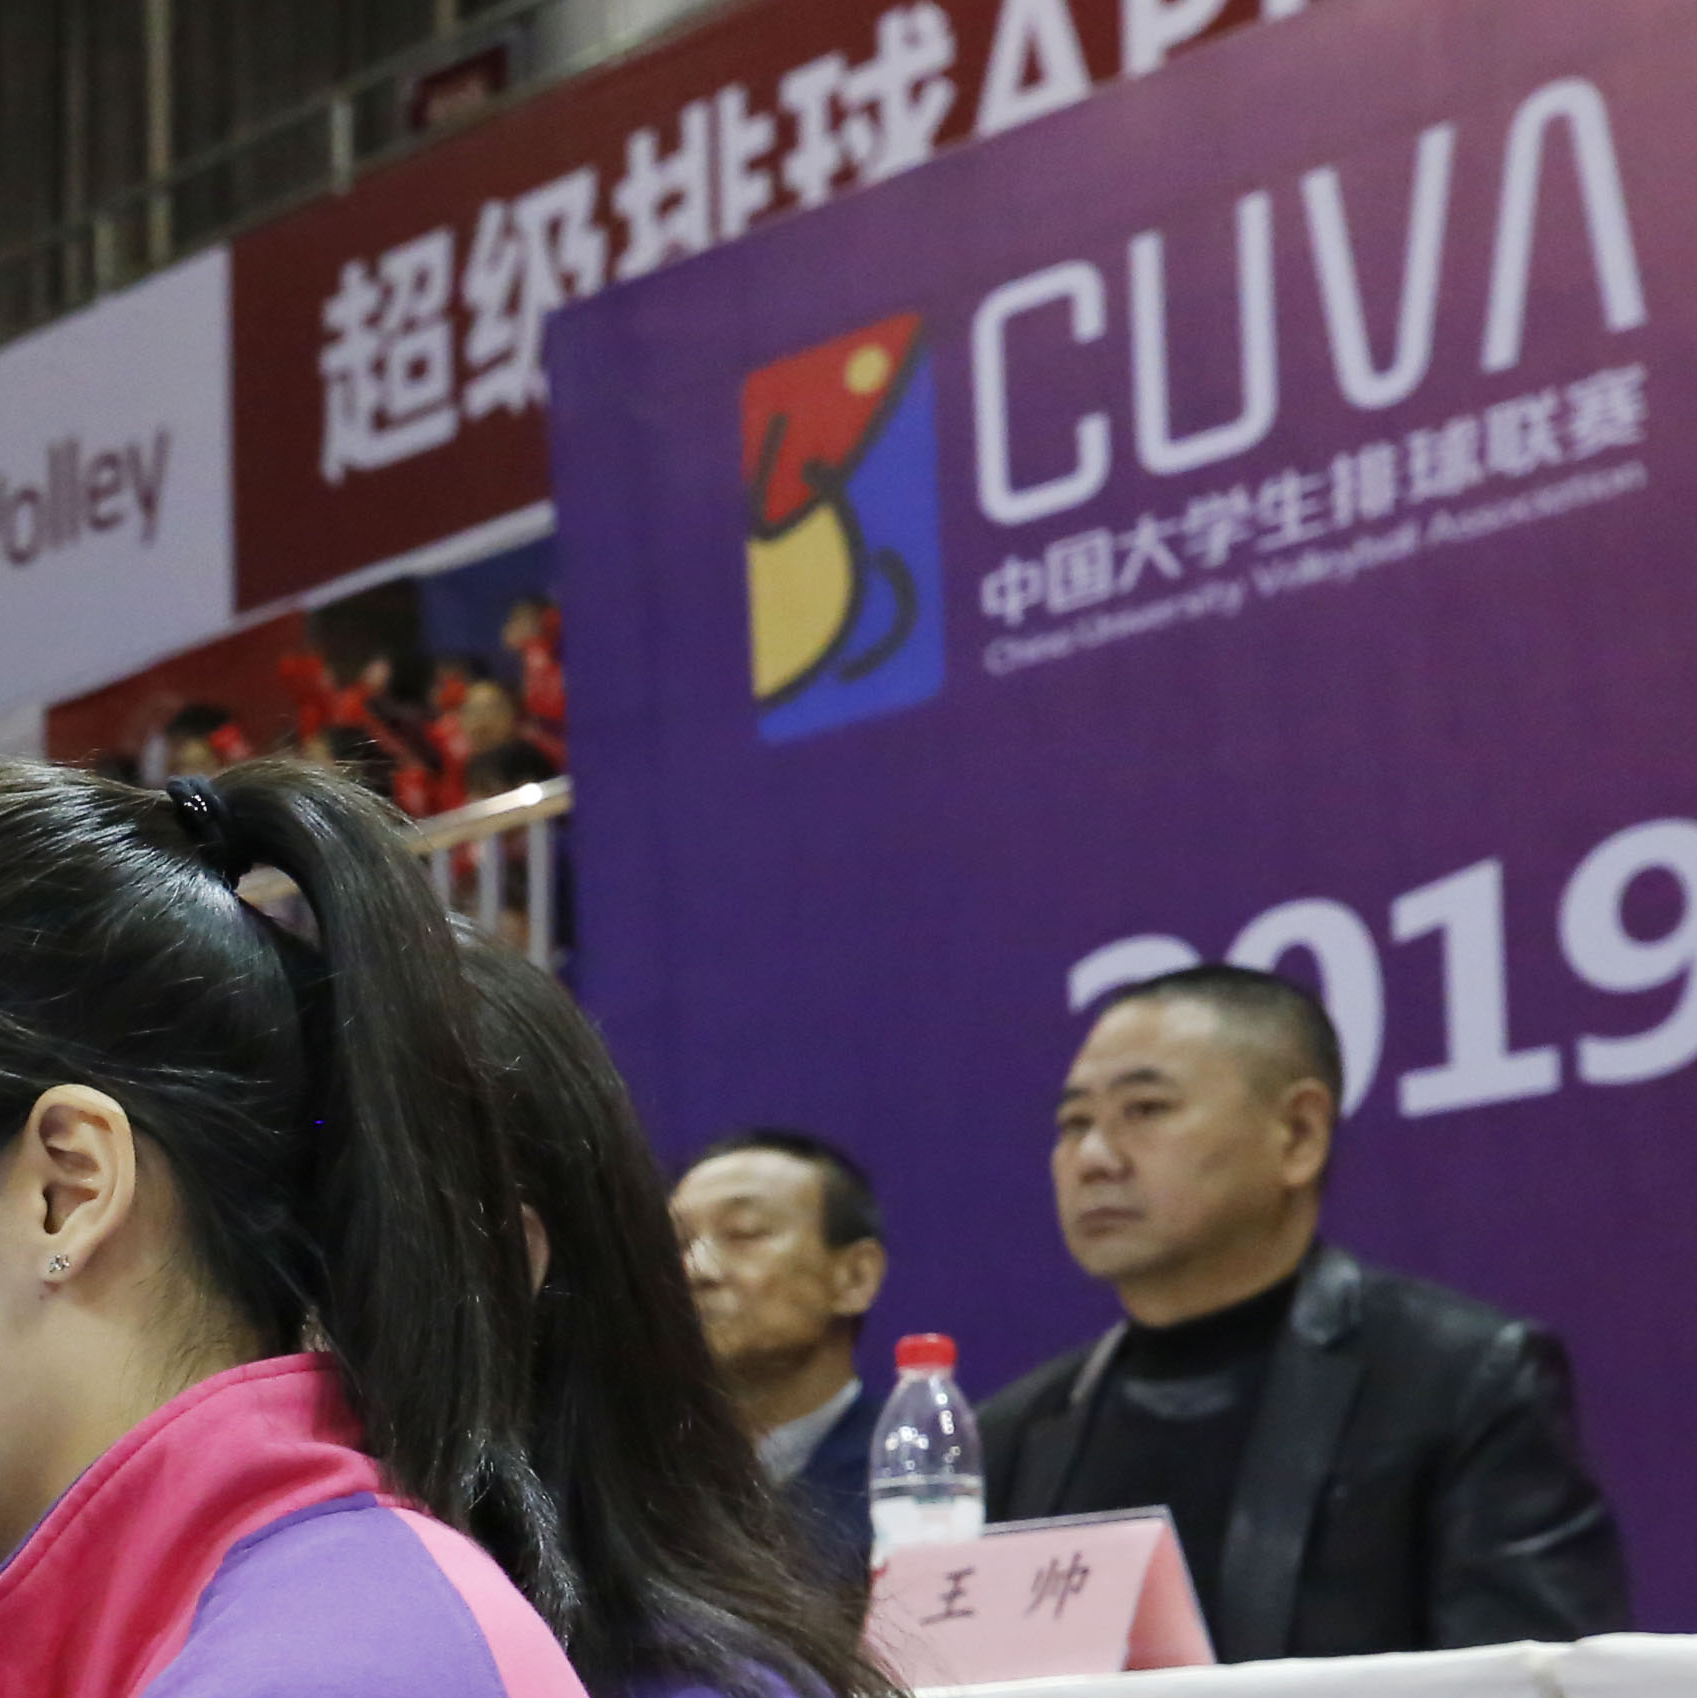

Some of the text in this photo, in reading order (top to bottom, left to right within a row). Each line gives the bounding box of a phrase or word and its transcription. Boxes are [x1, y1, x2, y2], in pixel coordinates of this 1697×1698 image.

[971, 76, 1648, 525] CUVA
[981, 362, 1647, 624] 中国大学生排球联赛
[1068, 817, 1697, 1120] 019
